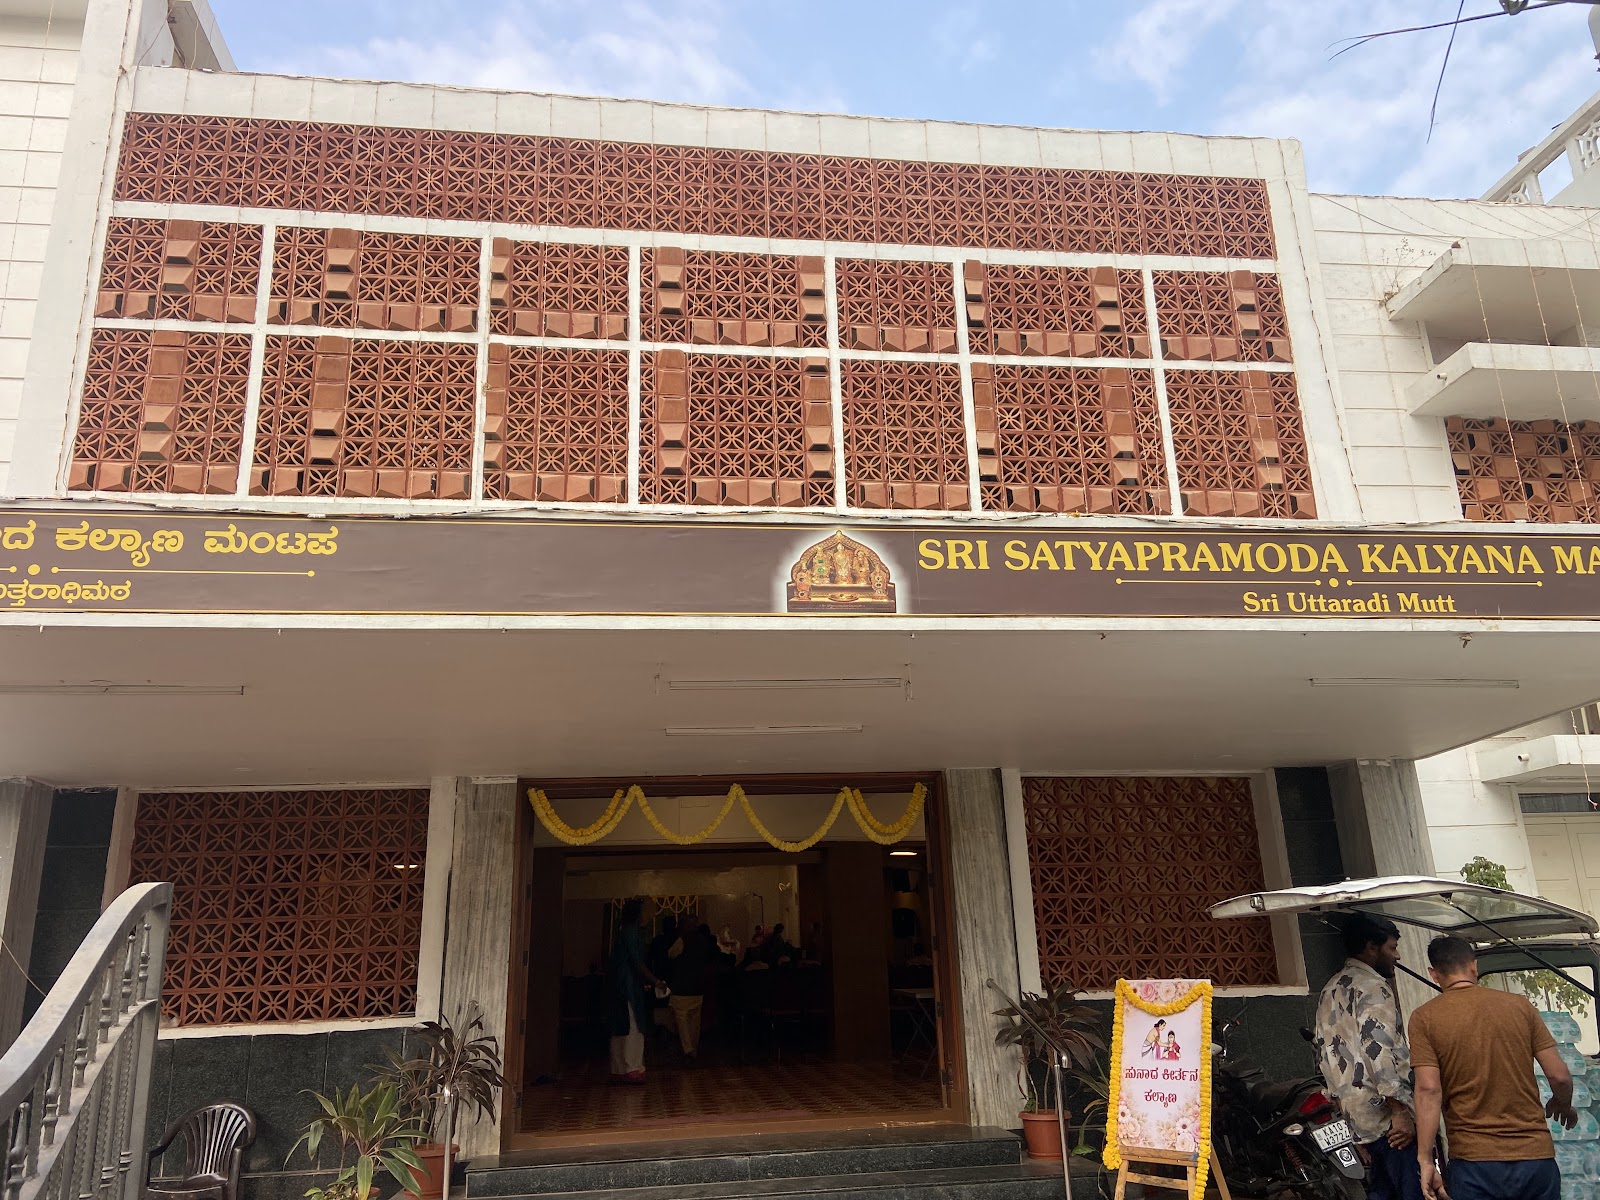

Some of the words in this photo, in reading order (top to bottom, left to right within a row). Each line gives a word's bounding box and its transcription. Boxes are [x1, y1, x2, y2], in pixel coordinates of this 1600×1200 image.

[0, 519, 37, 550] ದ
[55, 520, 185, 567] ಕಲ್ಯಾಣ
[203, 523, 339, 555] ಮಂಟಪ
[918, 539, 990, 570] SRI
[1004, 540, 1349, 573] SATYAPRAMODA
[1357, 543, 1544, 574] KALYANA
[1243, 591, 1278, 613] Sri
[1287, 592, 1391, 613] Uttaradi
[1397, 592, 1457, 613] Mutt
[1125, 1066, 1159, 1080] ಸುನಾದ
[1162, 1068, 1199, 1082] ಕೀರ್ತನ
[1144, 1089, 1177, 1108] ಕಲ್ಯಾಣ
